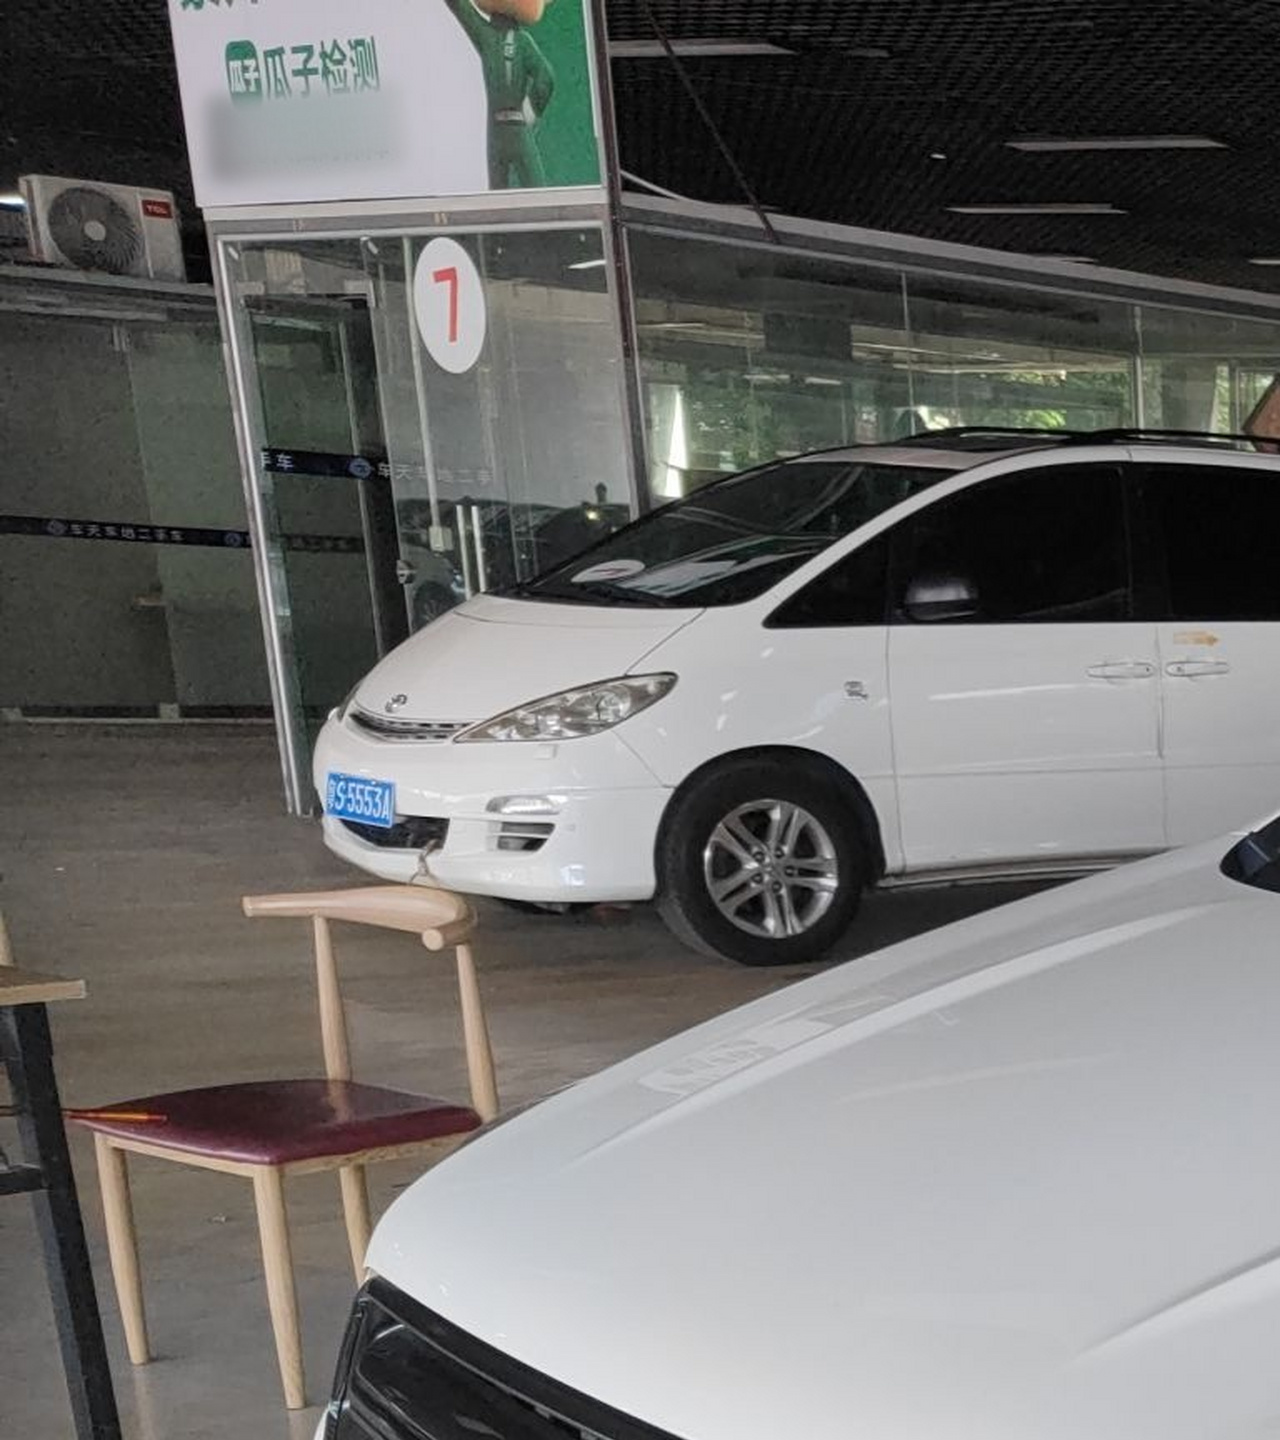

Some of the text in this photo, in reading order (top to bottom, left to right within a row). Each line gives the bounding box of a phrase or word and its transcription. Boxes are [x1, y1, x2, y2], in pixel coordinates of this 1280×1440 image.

[262, 36, 380, 101] 瓜子检测
[433, 266, 457, 342] 7
